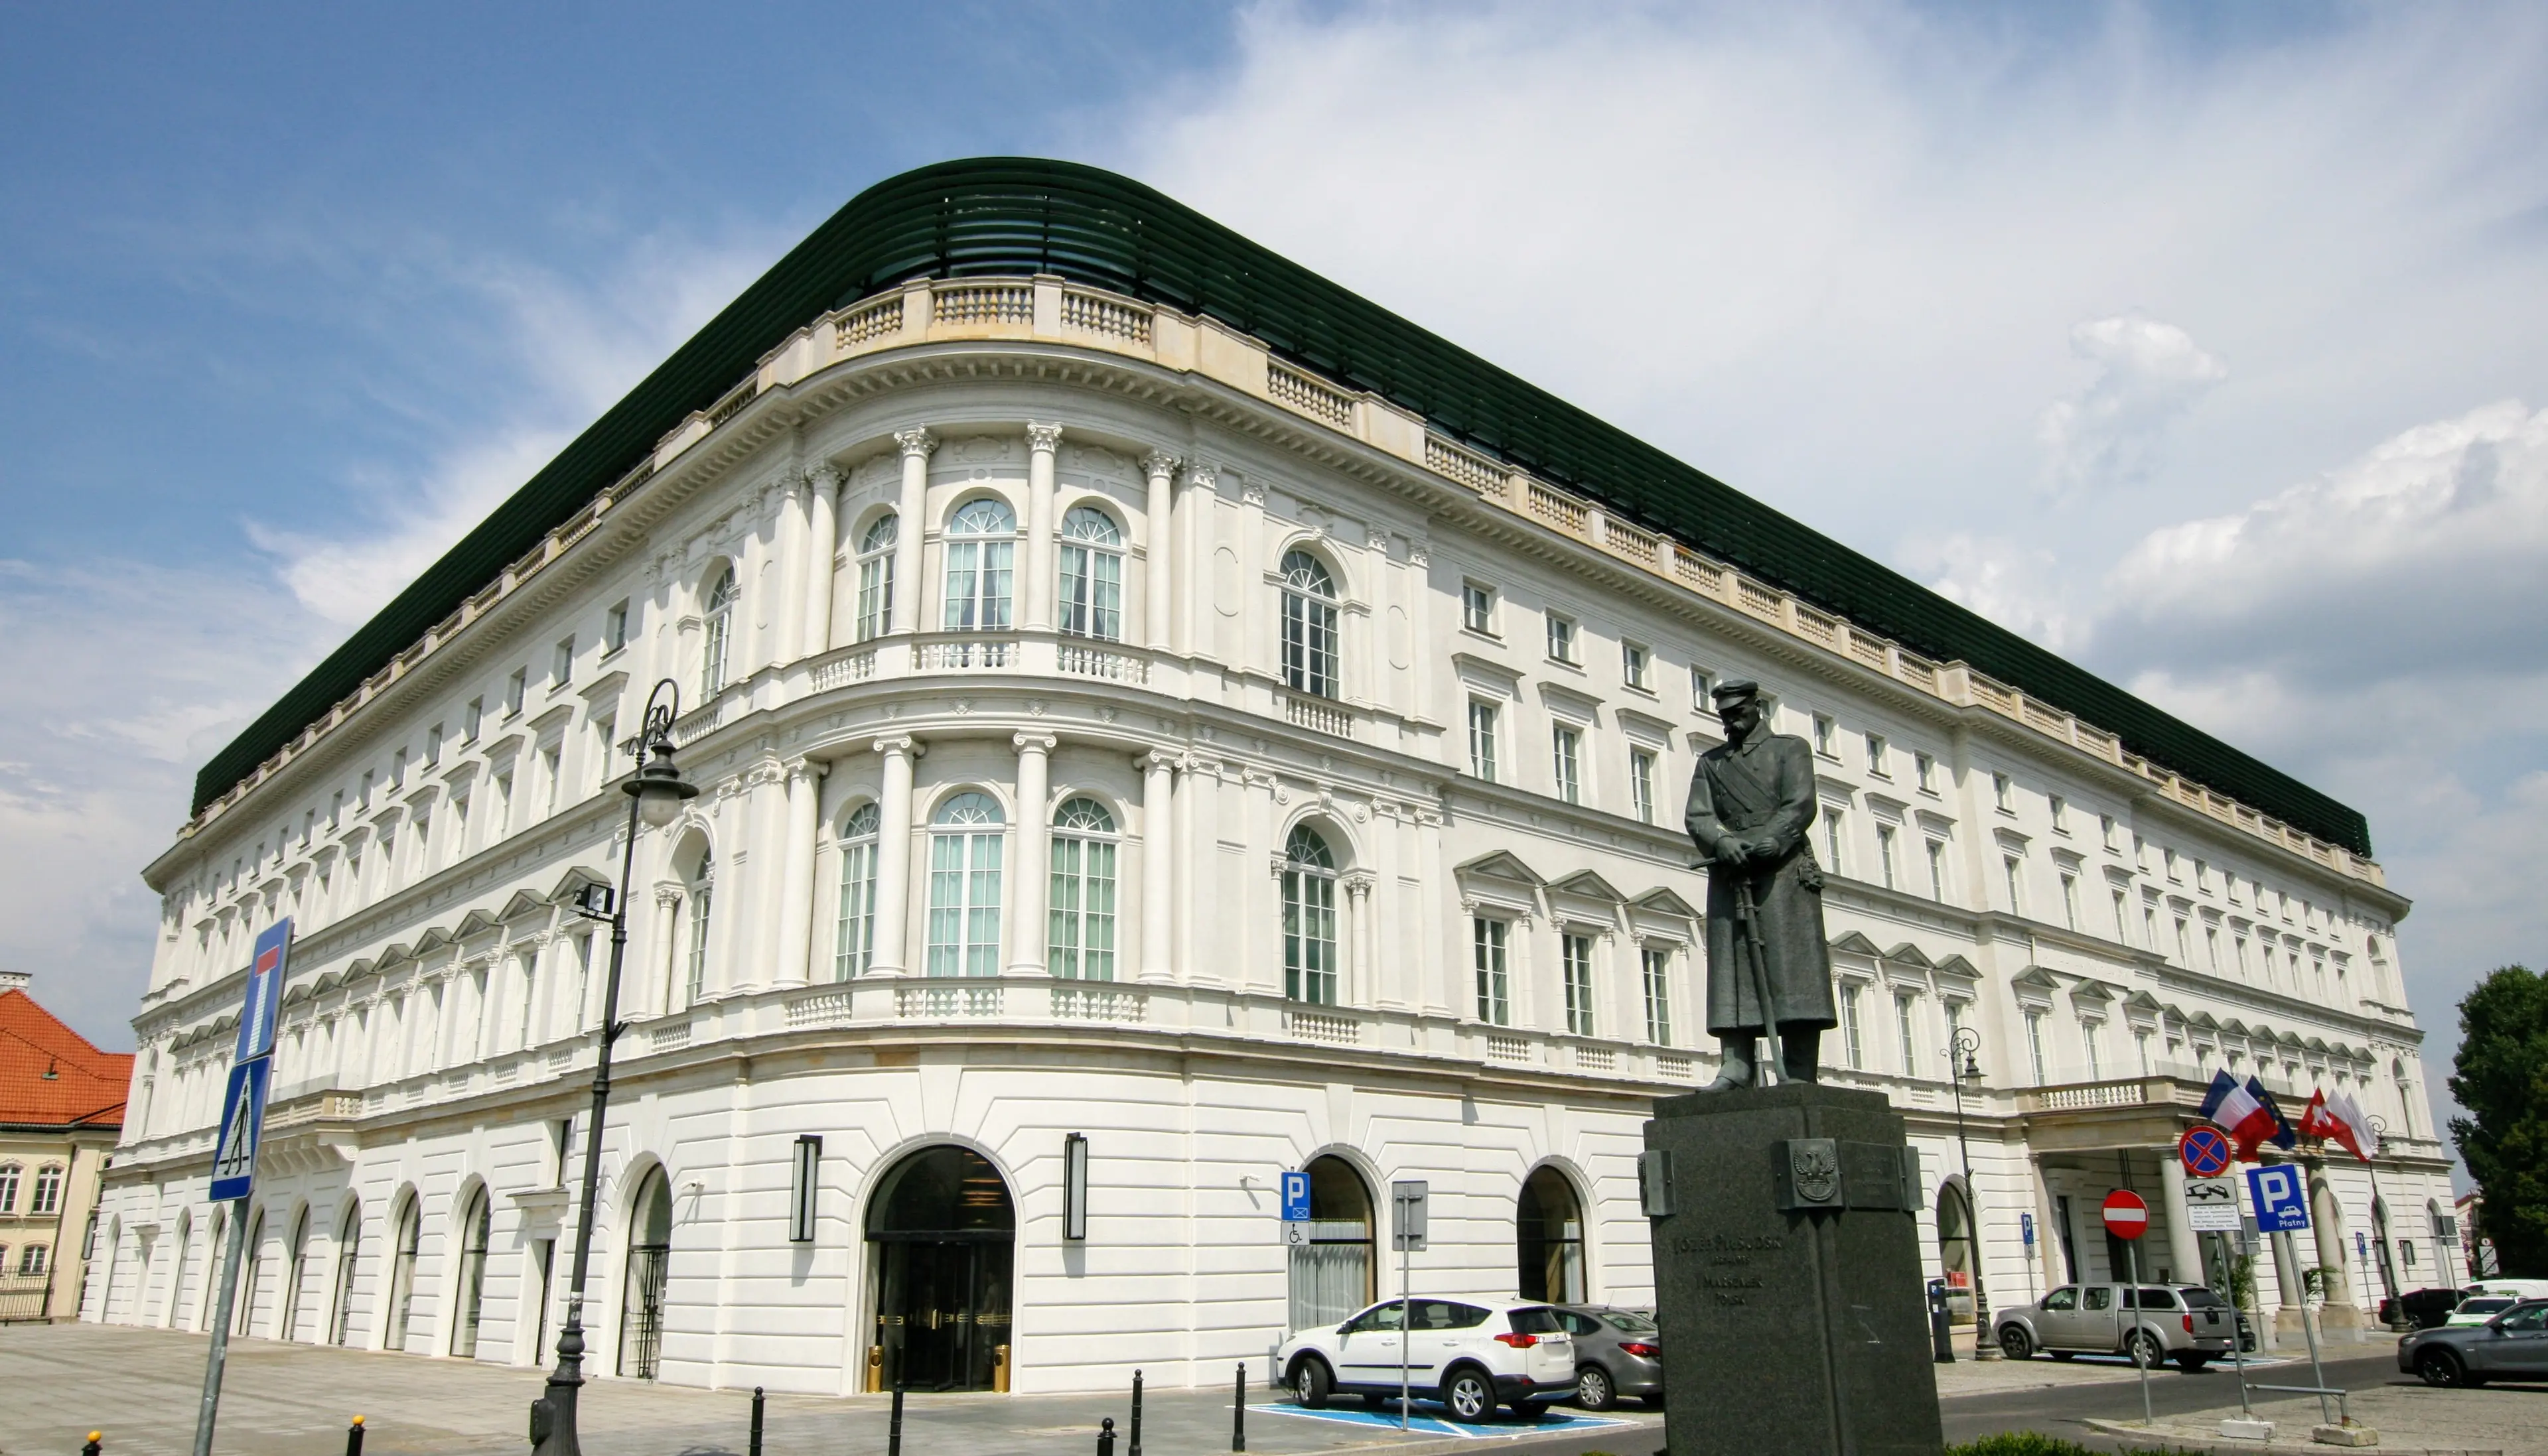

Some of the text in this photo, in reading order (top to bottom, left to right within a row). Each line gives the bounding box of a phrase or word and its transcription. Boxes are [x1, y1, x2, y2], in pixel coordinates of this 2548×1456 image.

[1288, 1176, 1304, 1207] P
[2258, 1171, 2291, 1213] P
[2023, 1217, 2031, 1236] P
[1931, 1285, 1937, 1293] P
